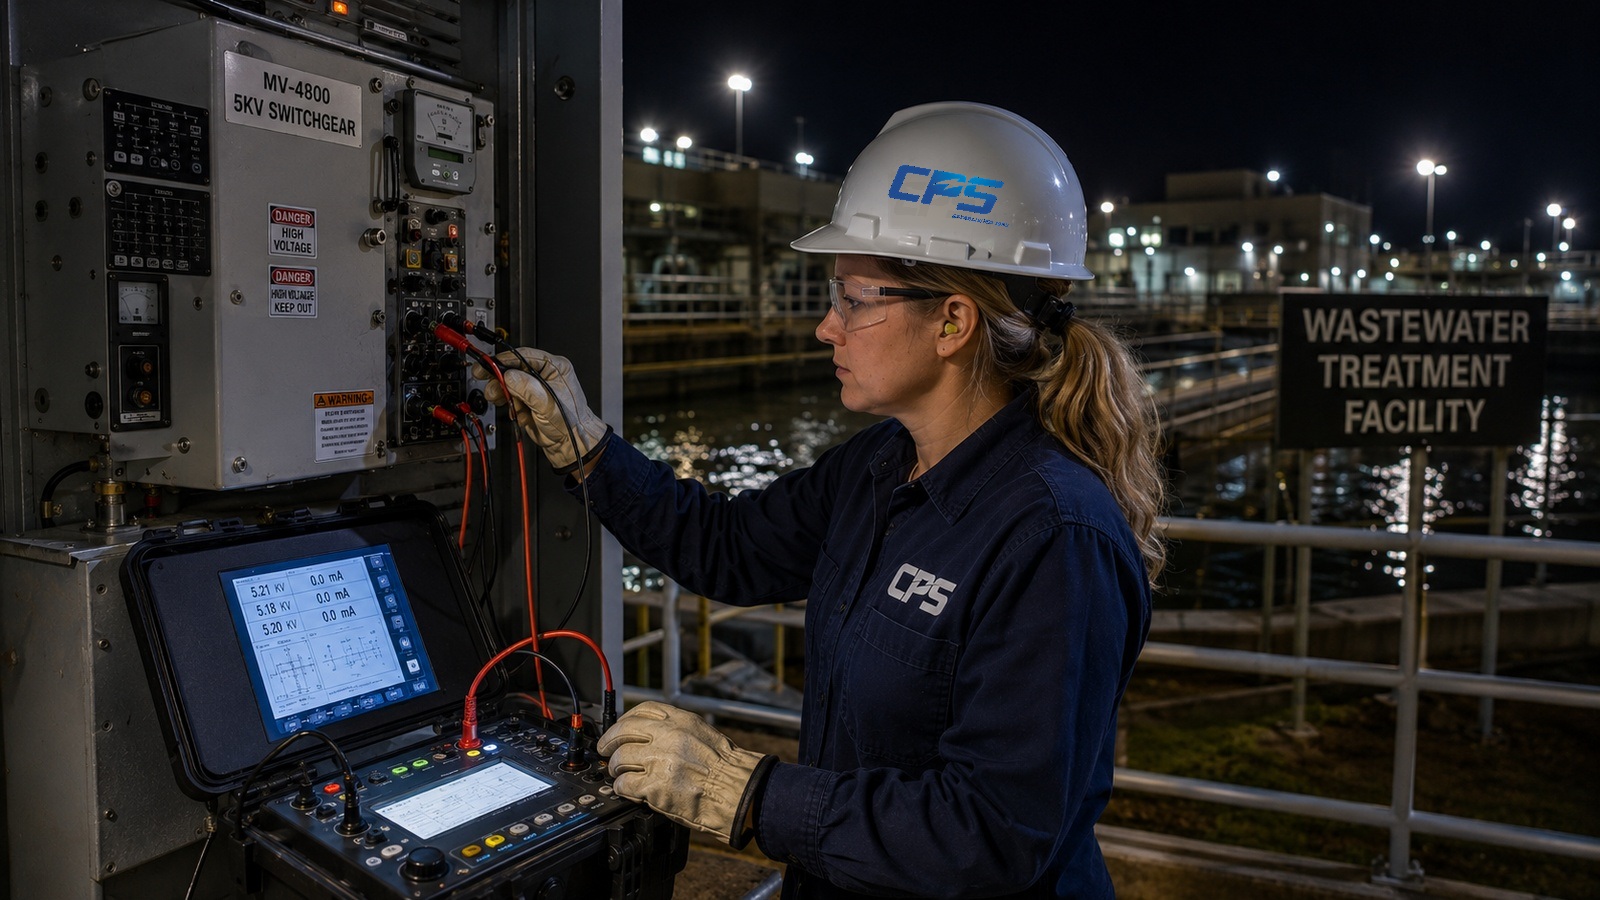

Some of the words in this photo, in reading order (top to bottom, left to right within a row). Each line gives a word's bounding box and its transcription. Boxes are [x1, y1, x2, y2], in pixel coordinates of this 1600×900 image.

[264, 71, 330, 104] MV-4800
[234, 93, 264, 116] 5KV
[268, 101, 356, 137] SWITCHGEAR
[888, 164, 1005, 214] CPS
[275, 210, 311, 224] DANGER
[282, 227, 304, 240] HIGH
[273, 239, 312, 254] VOLTAGE
[275, 270, 311, 283] DANGER
[274, 302, 295, 313] KEEP
[297, 302, 313, 314] OUT
[1302, 308, 1530, 343] WASTEWATER
[1317, 354, 1512, 389] TREATMENT
[328, 392, 367, 405] WARNING
[1344, 399, 1486, 434] FACILITY
[310, 573, 325, 586] 0.0
[328, 570, 344, 583] mA
[250, 584, 271, 598] 5.21
[274, 582, 286, 594] KV
[316, 591, 331, 604] 0.0
[335, 587, 350, 600] mA
[887, 563, 957, 616] CPS
[256, 602, 277, 617] 5.18
[280, 601, 291, 612] KV
[322, 609, 337, 623] 0.0
[341, 605, 357, 619] mA
[262, 621, 283, 636] 5.20
[286, 619, 297, 631] KV
